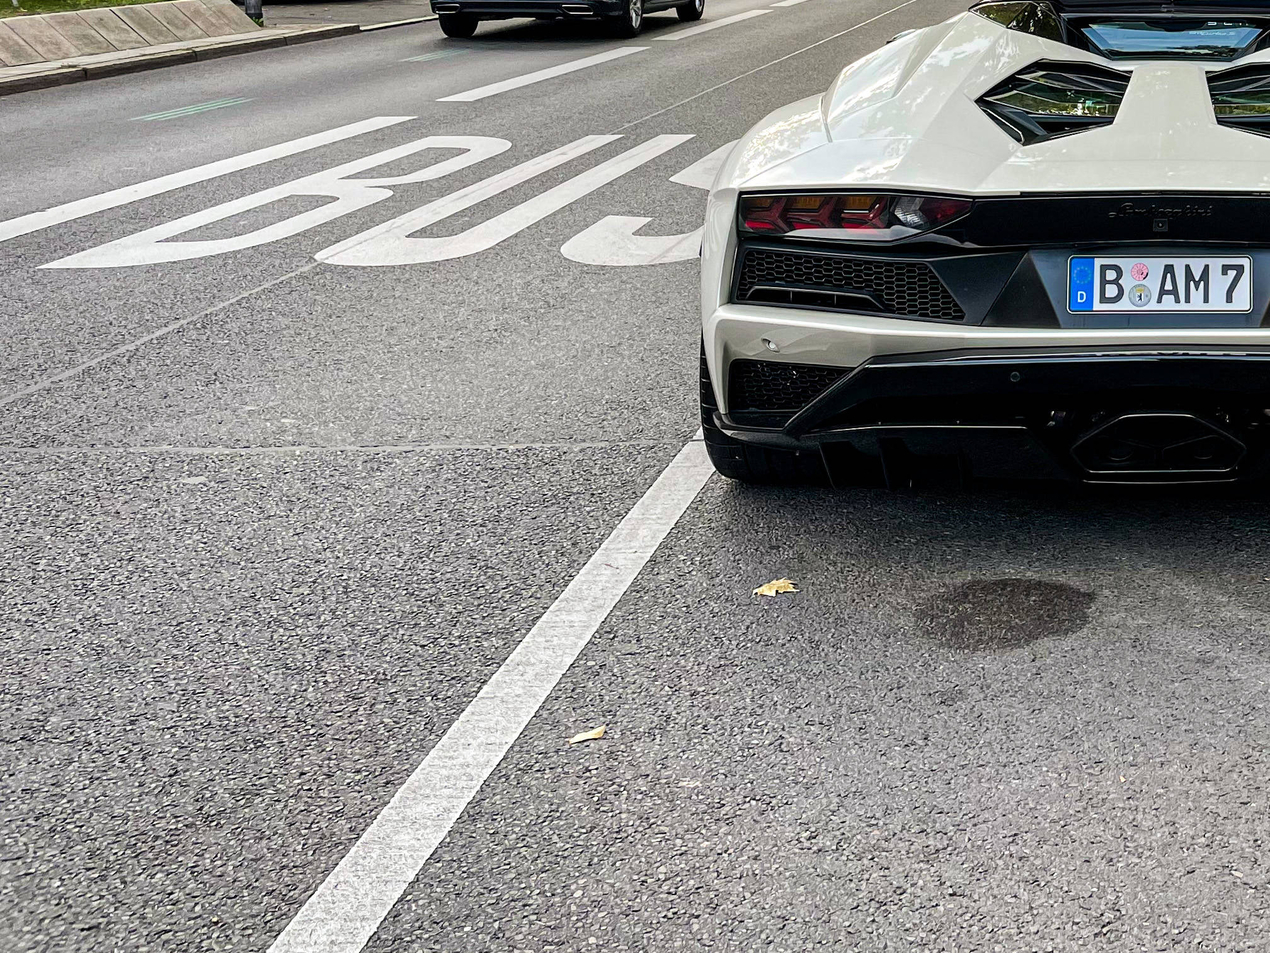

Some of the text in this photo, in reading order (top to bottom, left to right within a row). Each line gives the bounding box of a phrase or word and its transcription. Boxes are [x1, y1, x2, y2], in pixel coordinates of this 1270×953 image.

[1098, 263, 1246, 304] B AM 7
[1076, 291, 1087, 303] D
